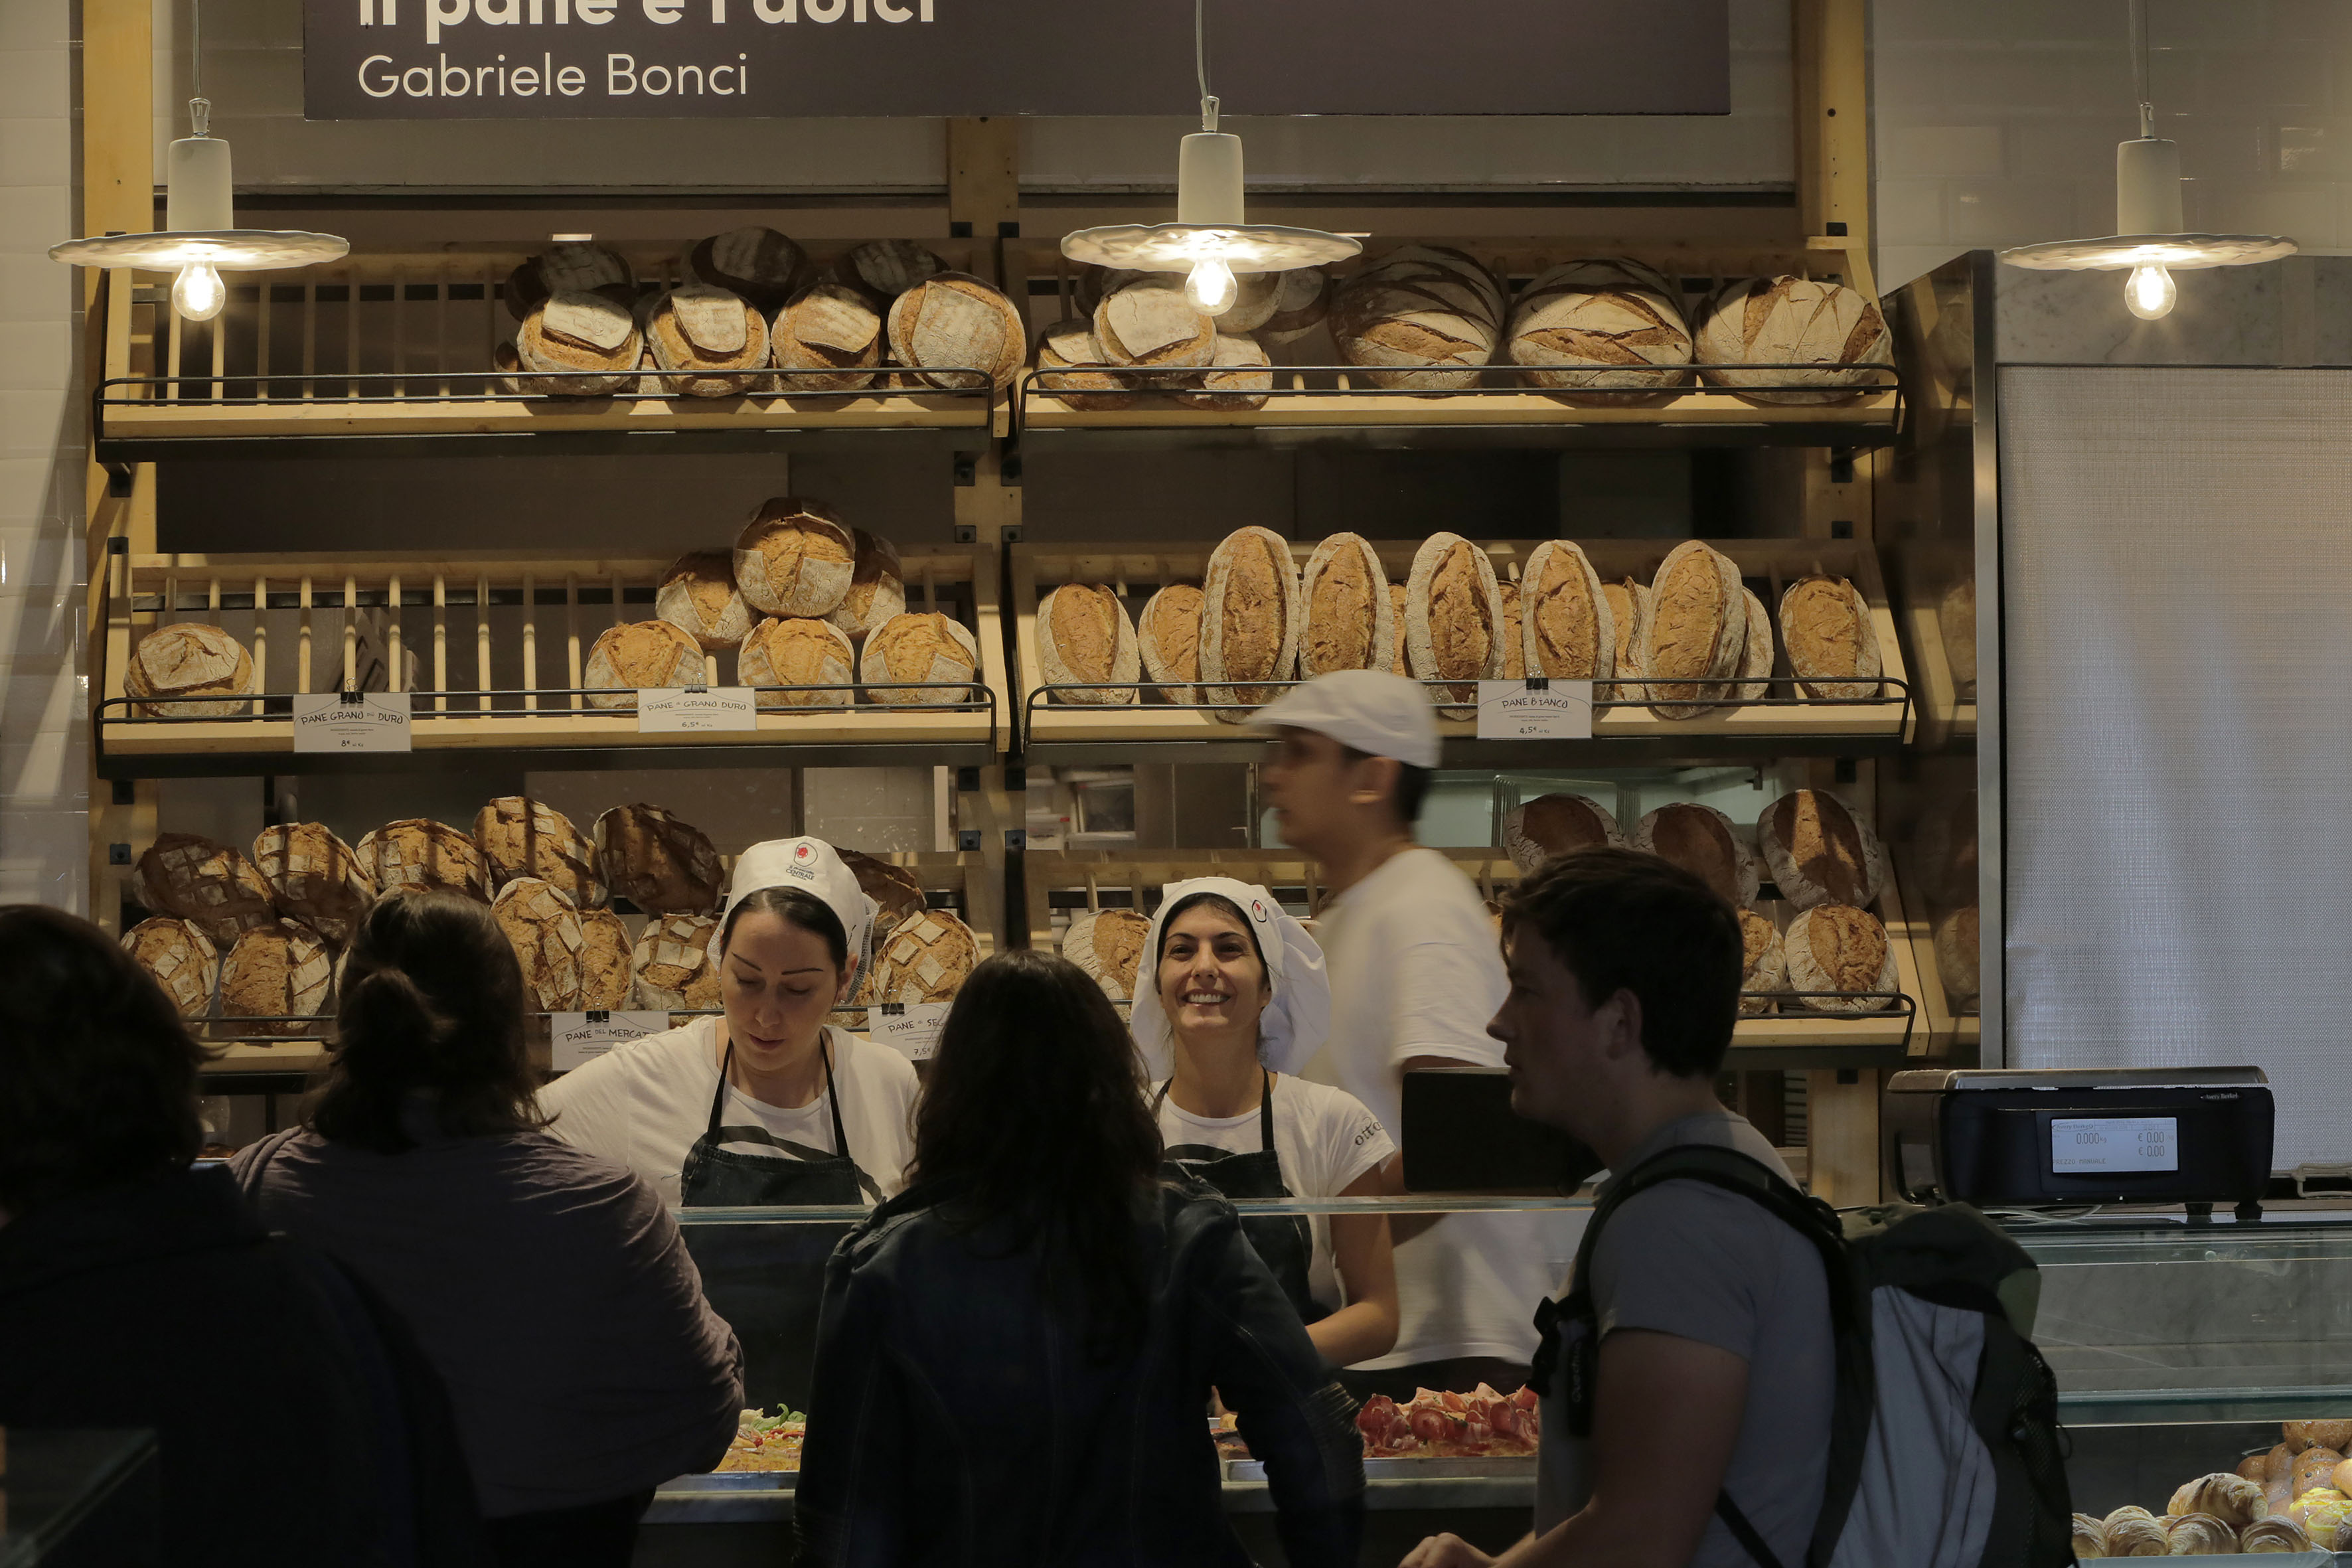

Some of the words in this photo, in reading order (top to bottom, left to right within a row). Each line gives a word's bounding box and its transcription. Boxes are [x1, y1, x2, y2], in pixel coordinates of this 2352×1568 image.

[358, 52, 586, 98] Gabriele
[608, 53, 747, 96] Bonci
[647, 702, 674, 712] PANE
[722, 702, 747, 710] DURO
[1502, 698, 1528, 708] PANE
[301, 713, 327, 725] PANE
[330, 711, 364, 721] GRANO
[378, 713, 403, 724] DURO
[786, 868, 815, 881] CENTRALE
[888, 1020, 915, 1033] PANE
[566, 1030, 592, 1042] PANE
[609, 1029, 655, 1038] MERCAT
[2146, 1131, 2164, 1143] 0.00
[2147, 1145, 2165, 1157] 0.00
